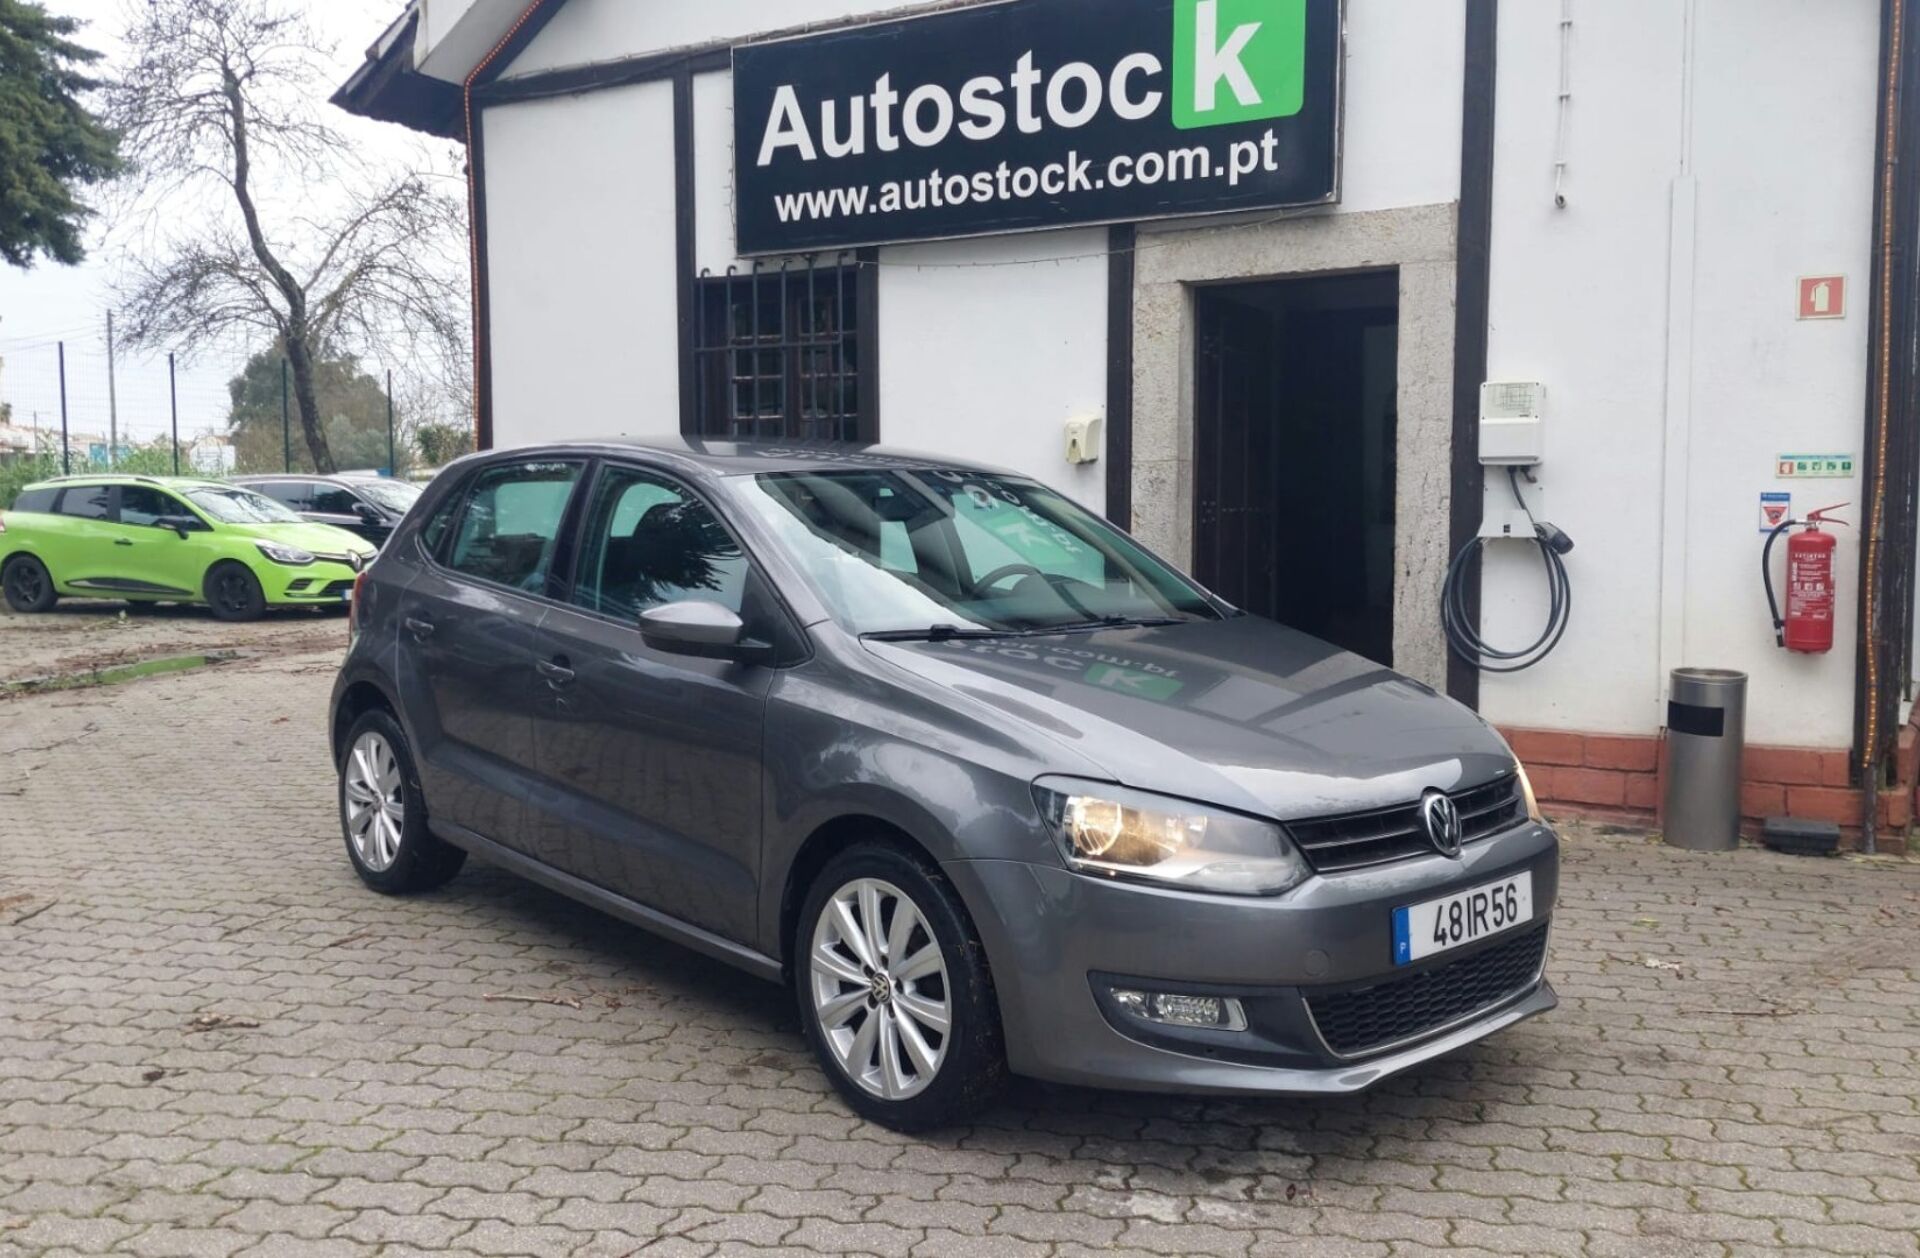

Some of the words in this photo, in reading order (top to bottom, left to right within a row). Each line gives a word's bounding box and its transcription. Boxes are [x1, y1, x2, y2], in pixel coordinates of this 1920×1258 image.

[757, 0, 1263, 167] Autostock
[774, 128, 1278, 222] www.autostock.com.pt
[1433, 882, 1518, 947] 48IR56
